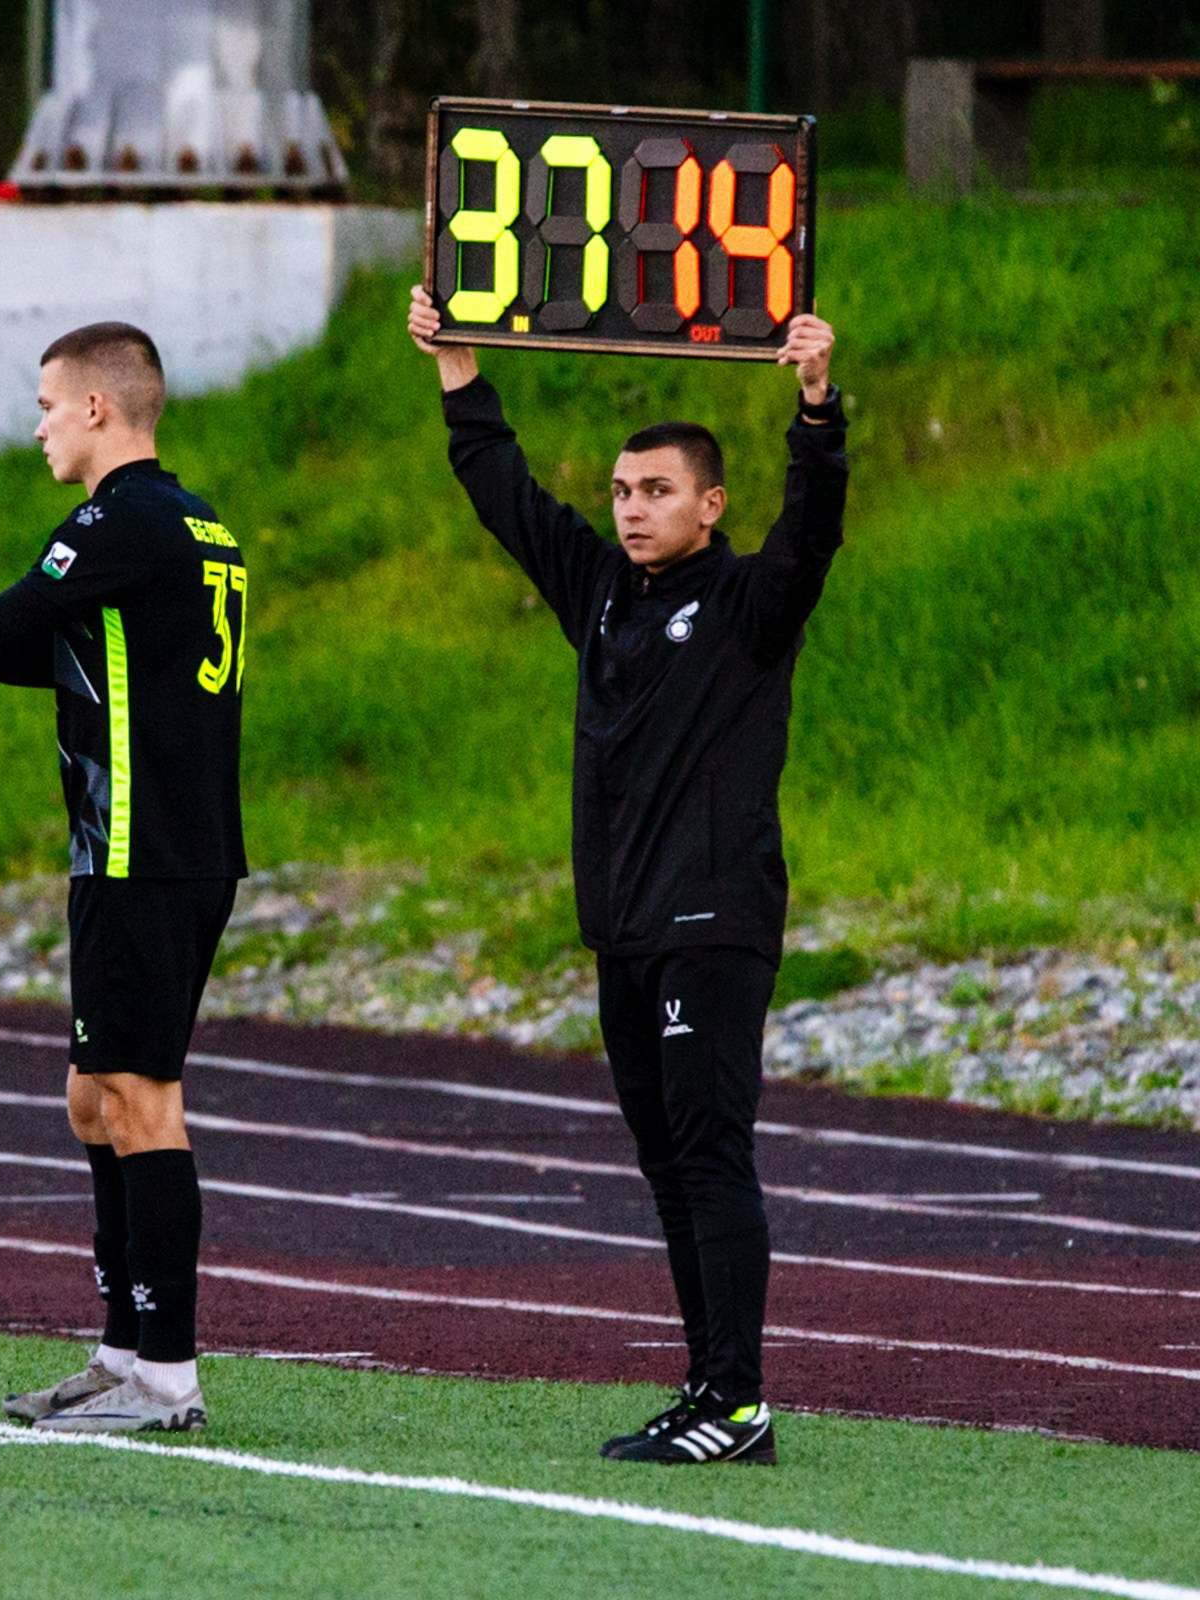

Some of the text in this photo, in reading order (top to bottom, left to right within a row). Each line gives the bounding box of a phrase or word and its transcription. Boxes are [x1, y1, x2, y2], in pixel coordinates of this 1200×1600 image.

[447, 127, 611, 323] 37
[673, 156, 795, 323] 14
[513, 315, 529, 332] IN
[691, 325, 721, 342] OUT
[197, 560, 247, 694] 37
